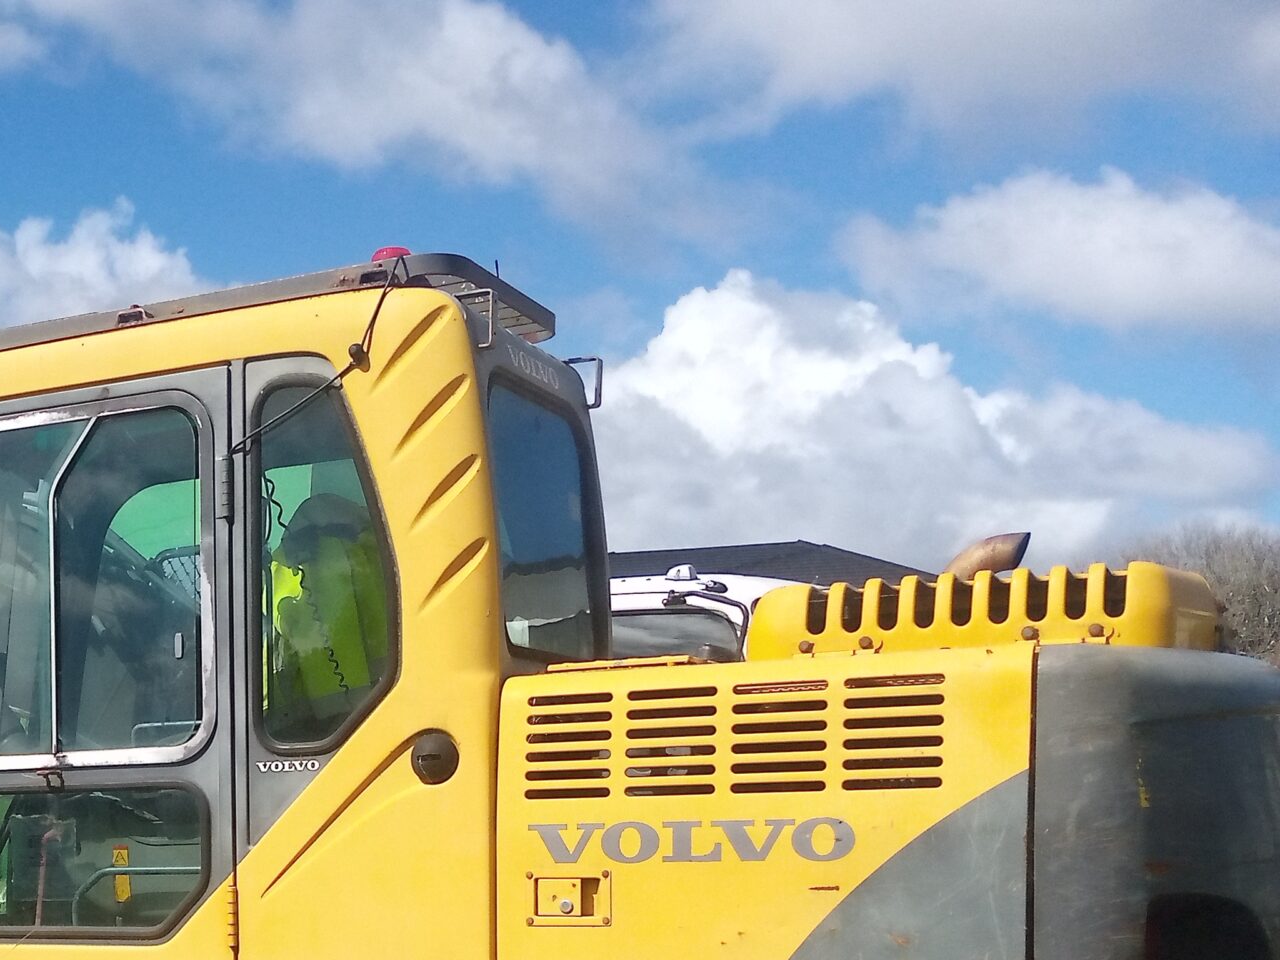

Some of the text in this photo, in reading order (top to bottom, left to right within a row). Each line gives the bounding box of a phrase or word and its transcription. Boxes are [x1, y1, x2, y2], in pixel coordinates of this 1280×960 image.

[506, 343, 559, 389] VOLVO
[256, 760, 320, 772] VOLVO
[528, 817, 856, 863] VOLVO
